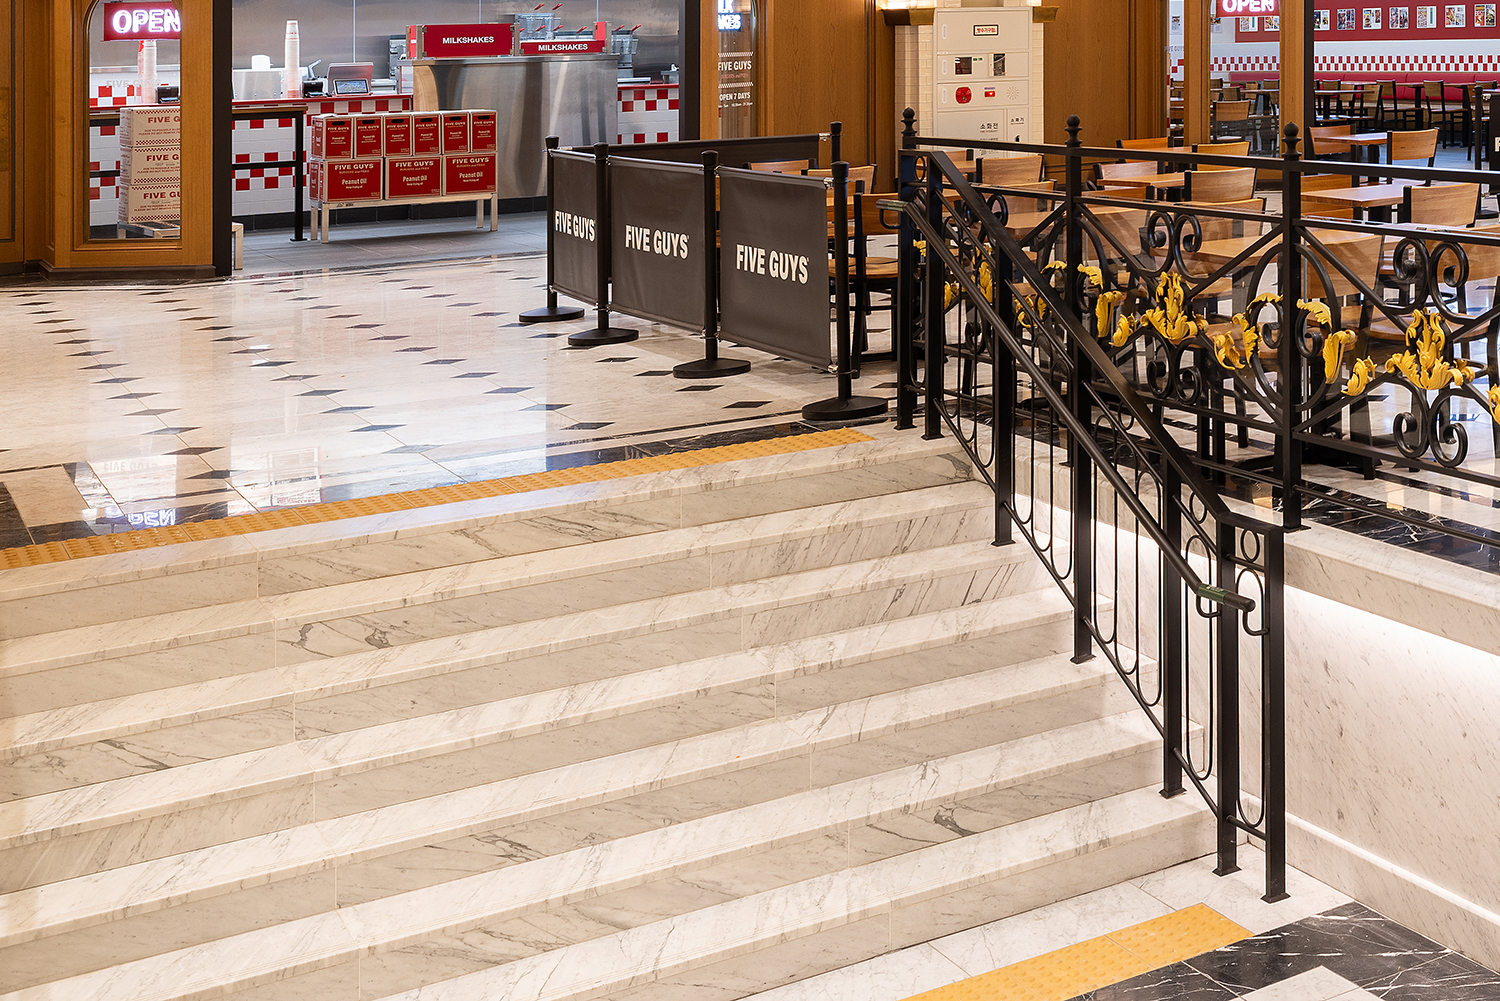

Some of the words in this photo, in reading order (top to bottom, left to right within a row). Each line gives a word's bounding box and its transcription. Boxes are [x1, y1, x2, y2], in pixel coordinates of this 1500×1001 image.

[112, 9, 181, 33] OPEN
[442, 36, 495, 44] MILKSHAKES
[538, 43, 588, 51] MILKSHAKES
[718, 61, 732, 70] FIVE
[734, 61, 752, 70] GUYS
[555, 210, 571, 234] FIVE
[573, 214, 596, 242] GUYS
[625, 225, 650, 252] FIVE
[654, 230, 688, 259] GUYS
[736, 244, 765, 275] FIVE
[769, 251, 808, 284] GUYS
